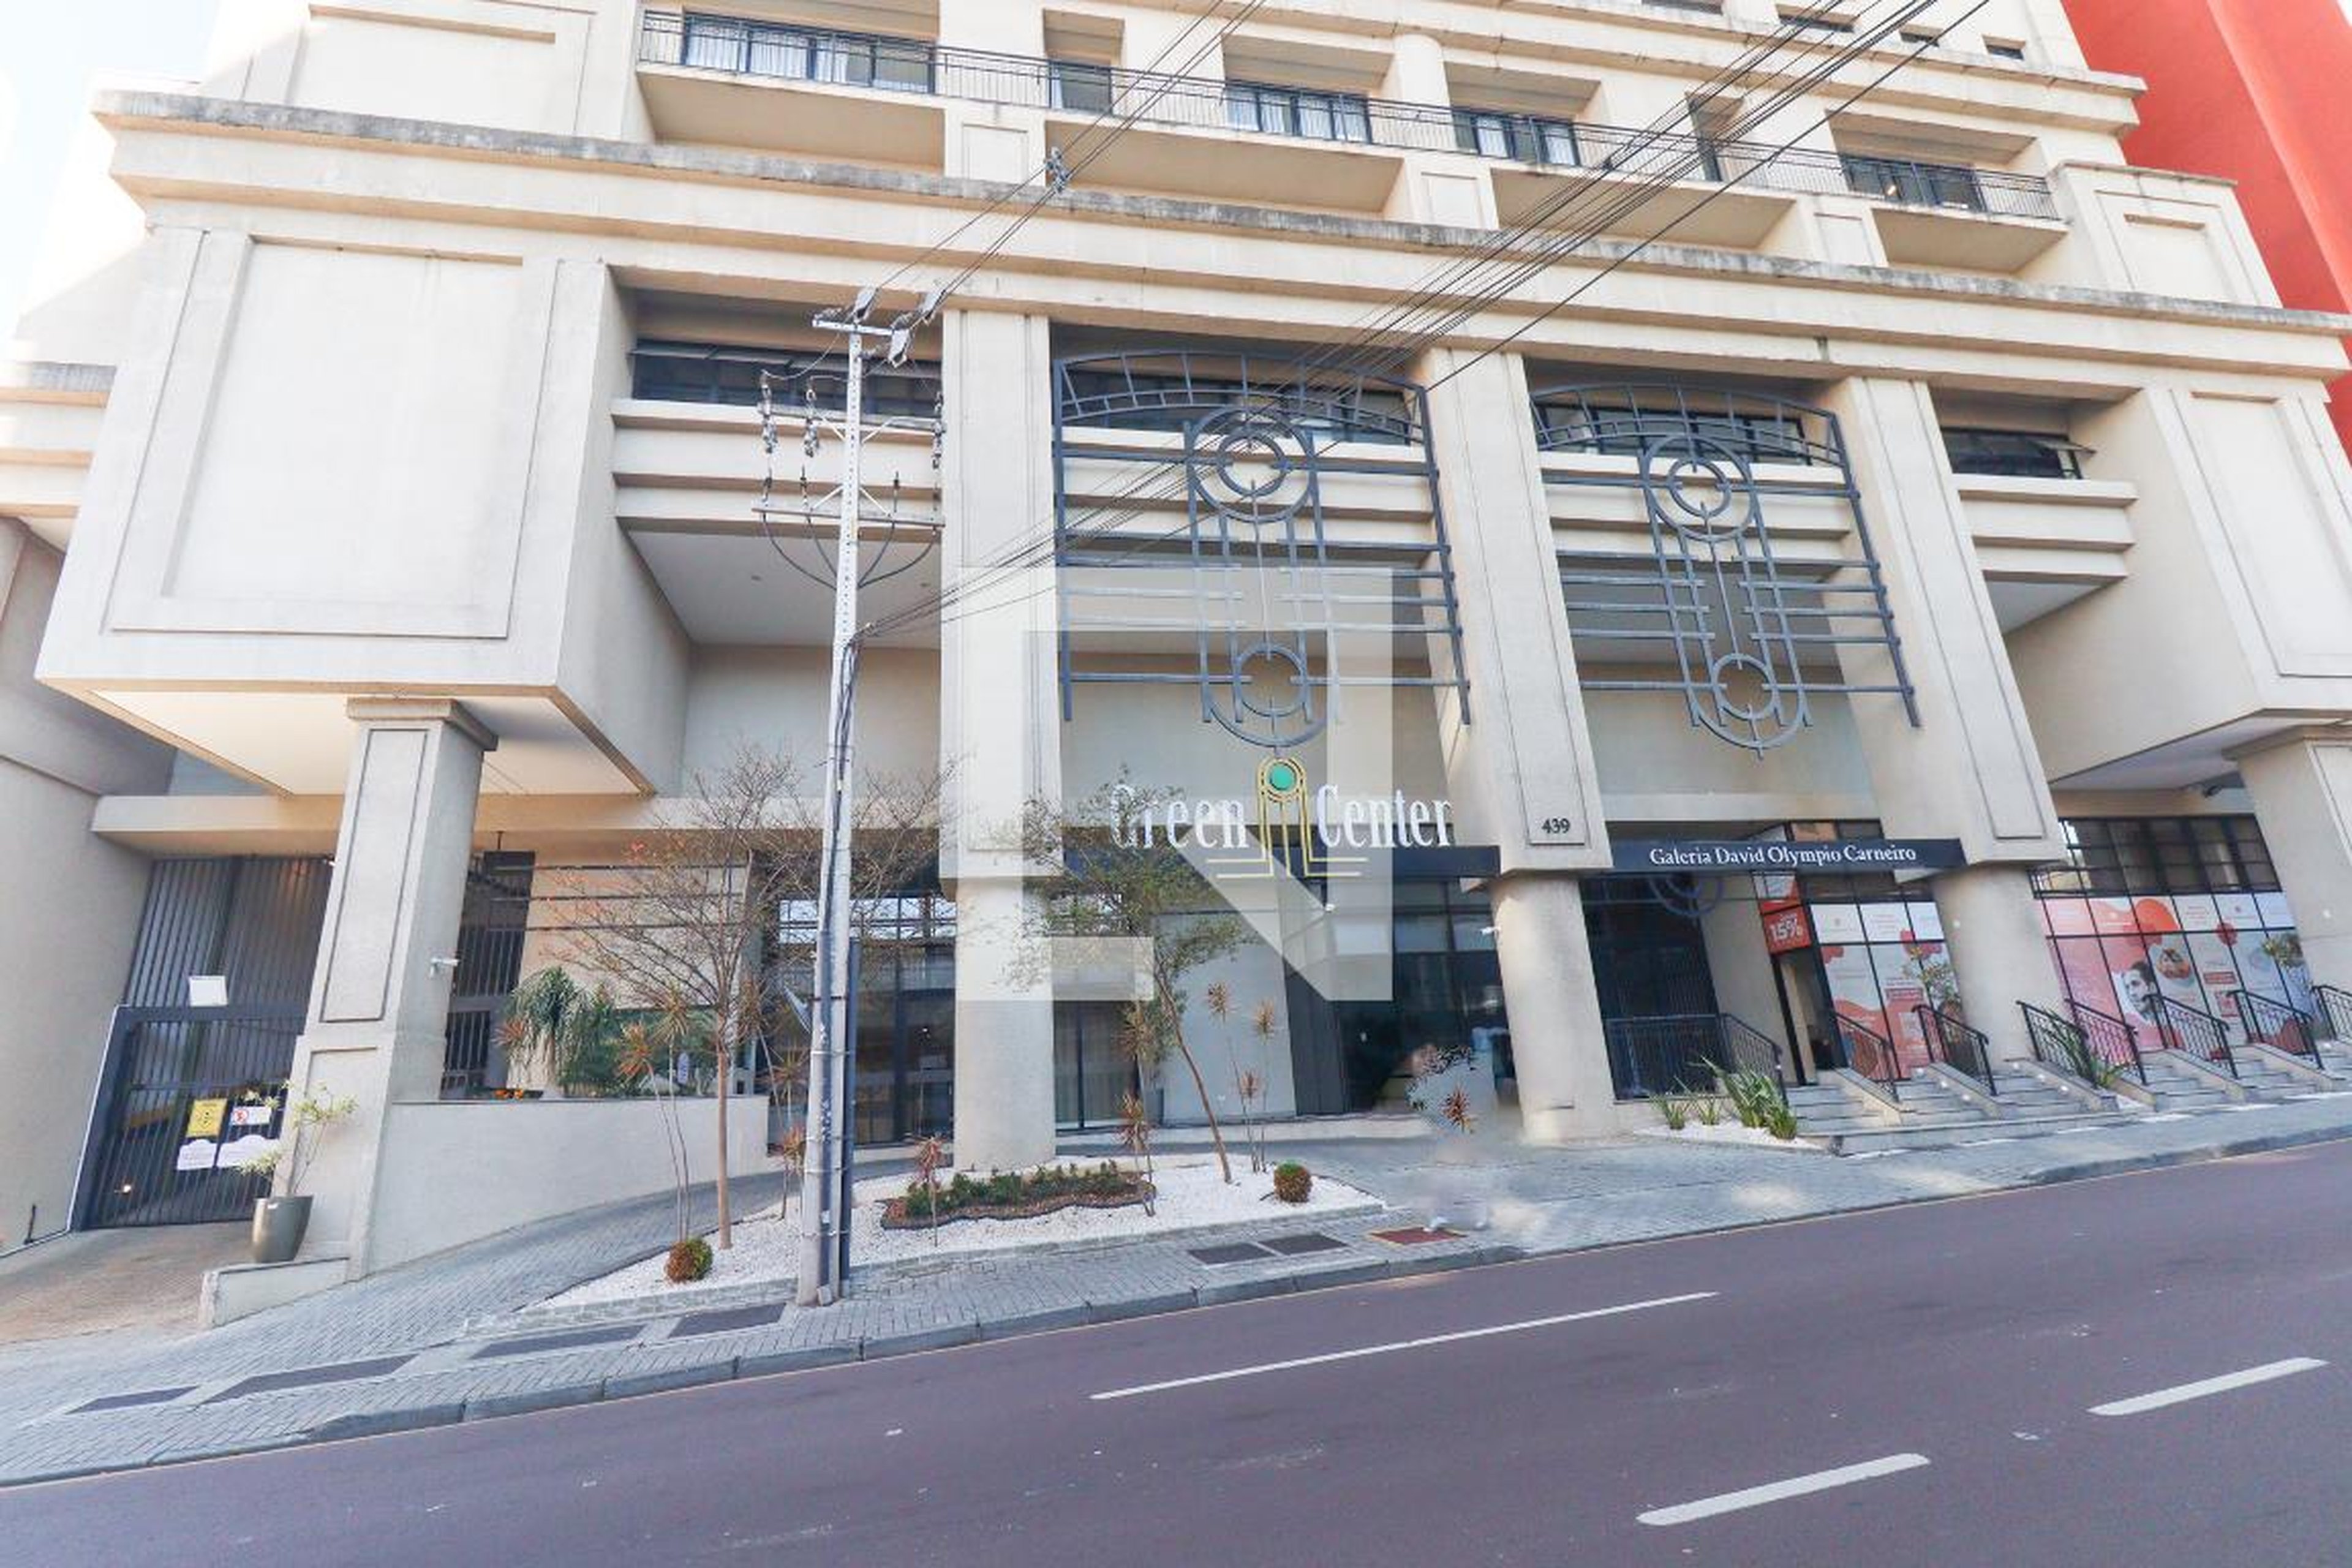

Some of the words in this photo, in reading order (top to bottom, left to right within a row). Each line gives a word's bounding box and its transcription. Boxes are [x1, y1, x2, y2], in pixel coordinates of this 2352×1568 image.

[1110, 783, 1250, 850] Green
[1317, 783, 1451, 848] Center
[1541, 817, 1571, 834] 439
[1649, 846, 1712, 865] Galeria
[1715, 846, 1765, 864] David
[1767, 845, 1841, 866] Olympio
[1844, 844, 1917, 861] Carneiro
